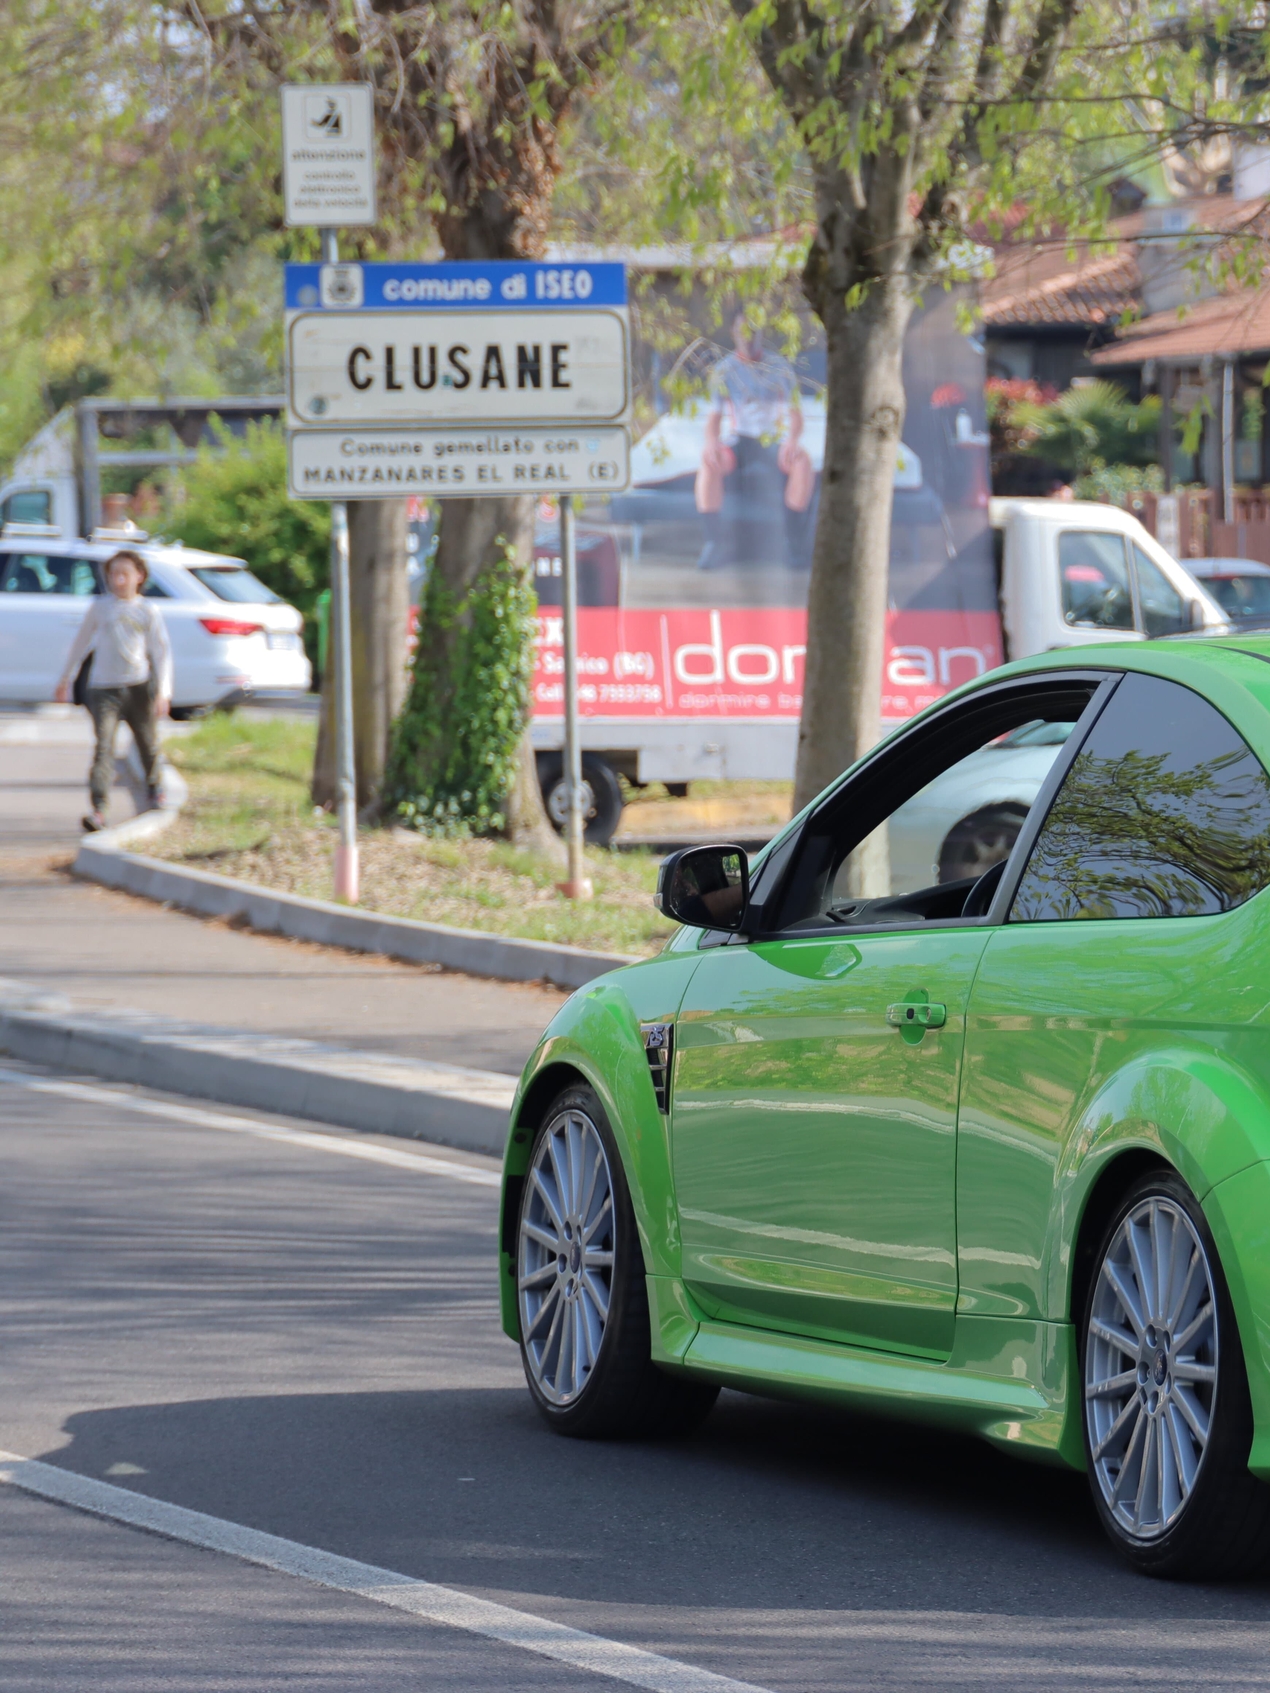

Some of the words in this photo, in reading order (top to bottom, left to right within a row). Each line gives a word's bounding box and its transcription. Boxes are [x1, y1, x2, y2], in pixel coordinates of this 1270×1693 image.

[382, 277, 493, 301] comune
[501, 271, 527, 300] di
[535, 269, 594, 300] ISEO
[347, 343, 572, 391] CLUSANE
[340, 437, 424, 457] Comune
[434, 435, 535, 458] gemellato
[543, 438, 580, 453] con
[303, 464, 465, 484] MANZANARES
[477, 464, 502, 482] EL
[513, 463, 570, 482] REAL
[588, 461, 619, 482] (E)
